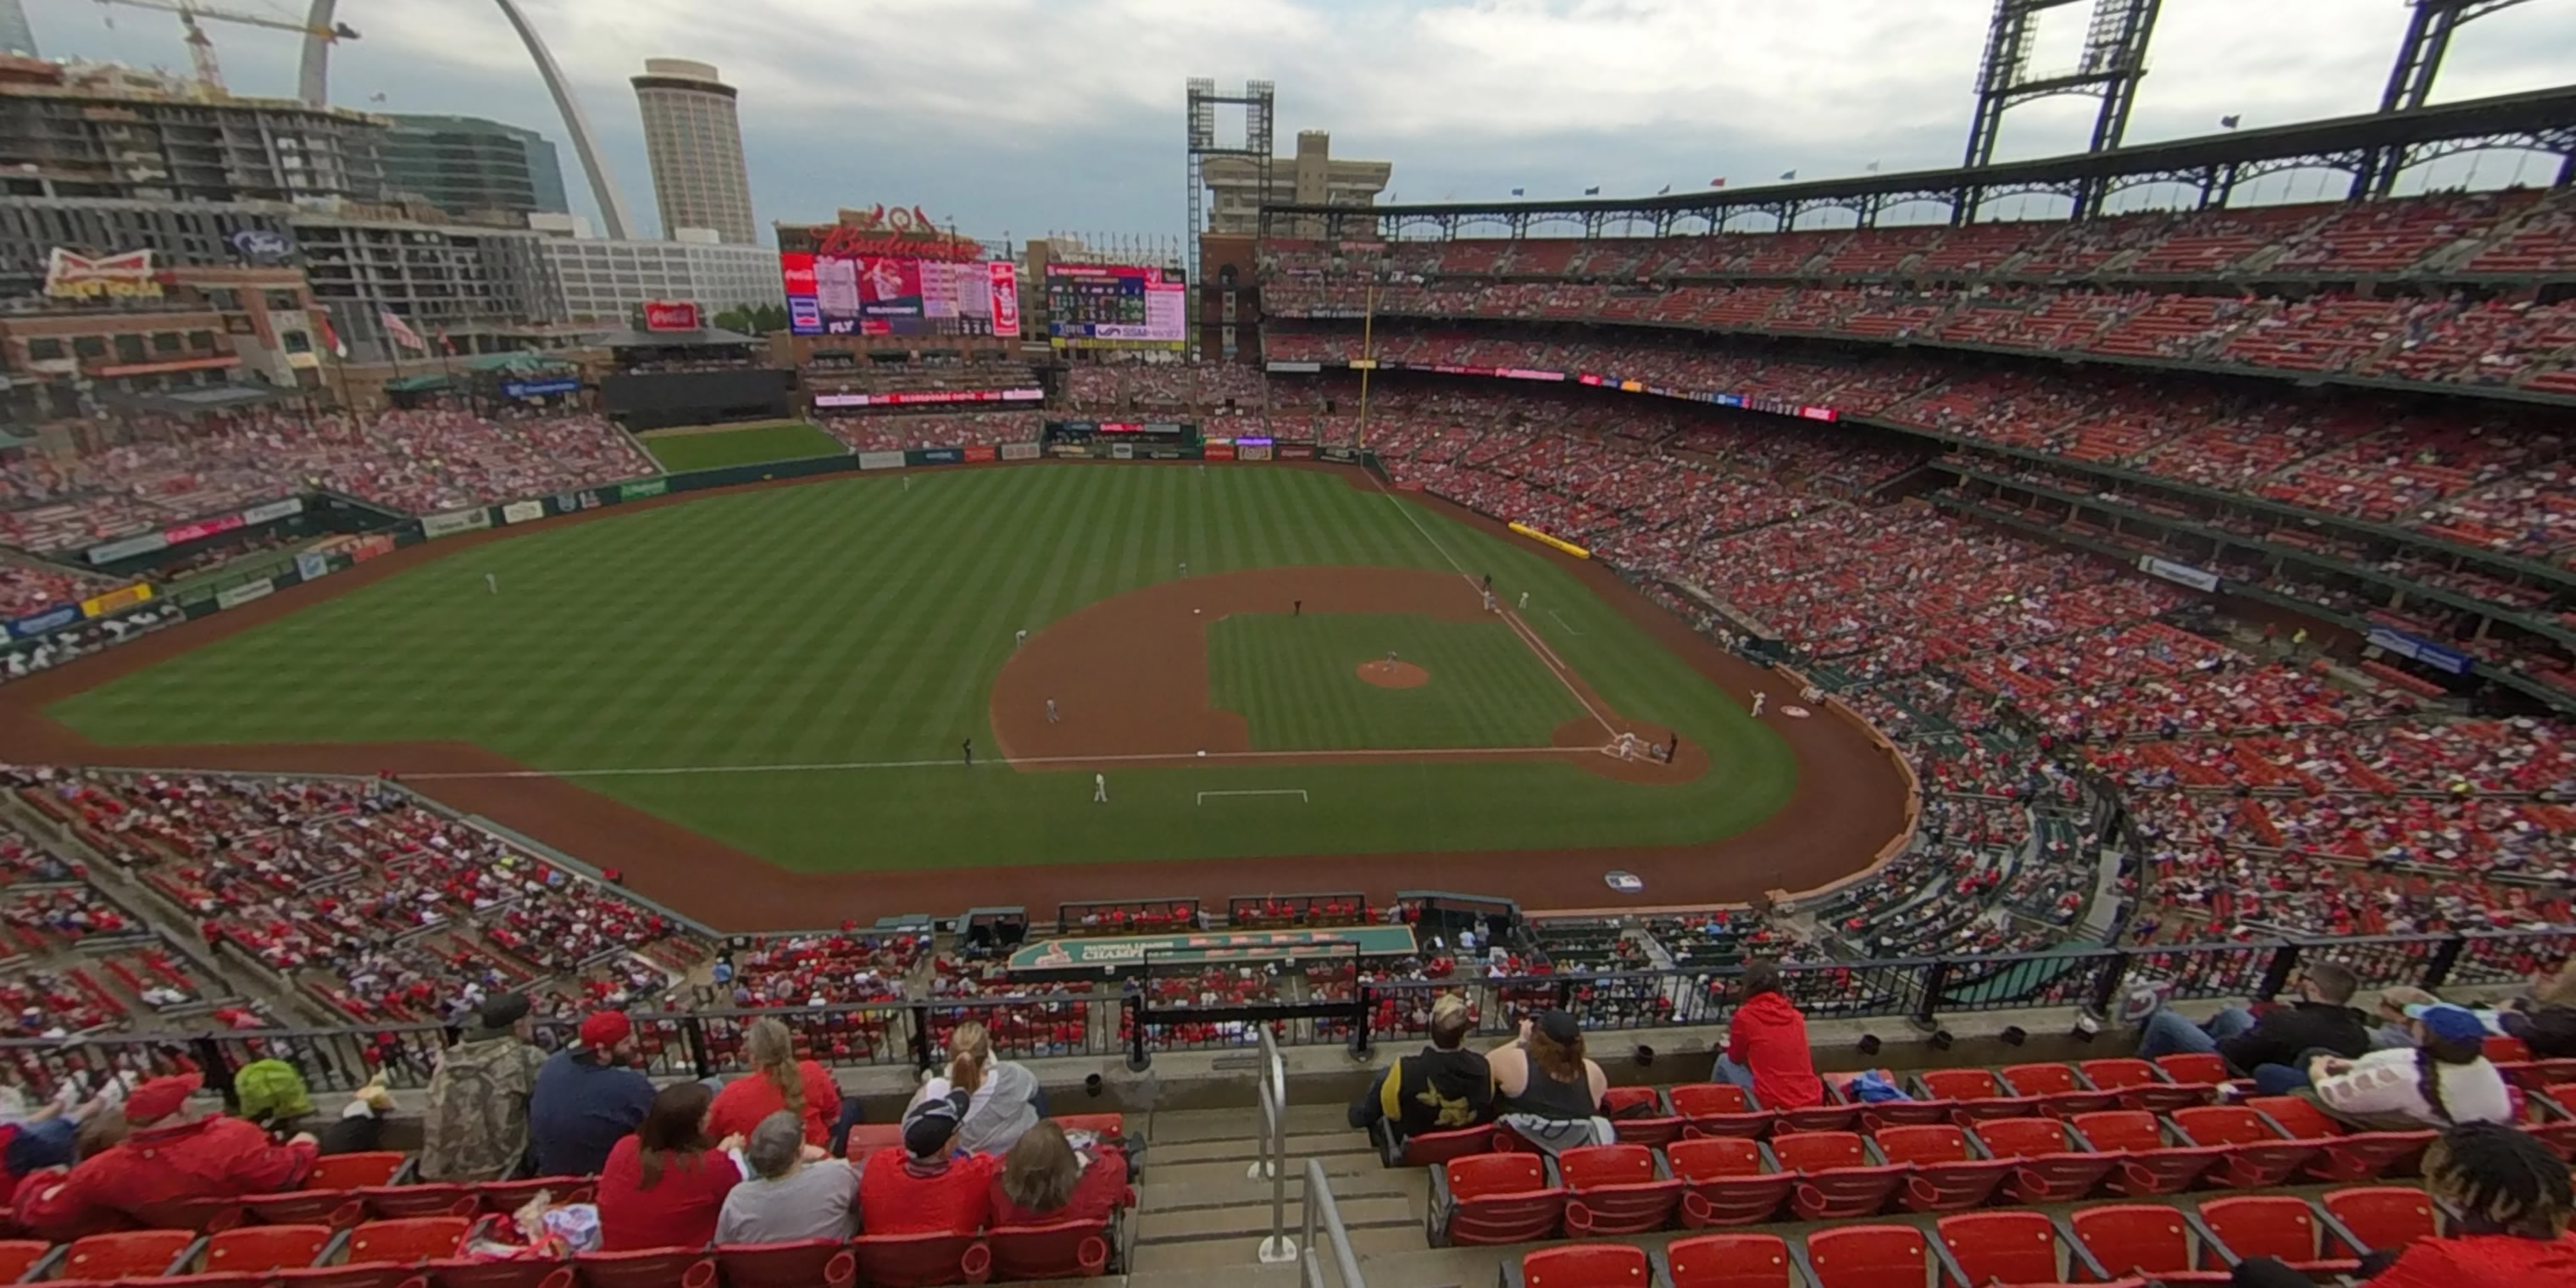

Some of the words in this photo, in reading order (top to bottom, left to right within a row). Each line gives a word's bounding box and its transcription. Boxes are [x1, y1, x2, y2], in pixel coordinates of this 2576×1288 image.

[811, 225, 985, 255] Budweiser
[829, 320, 853, 334] FLY
[1123, 327, 1146, 337] SSM
